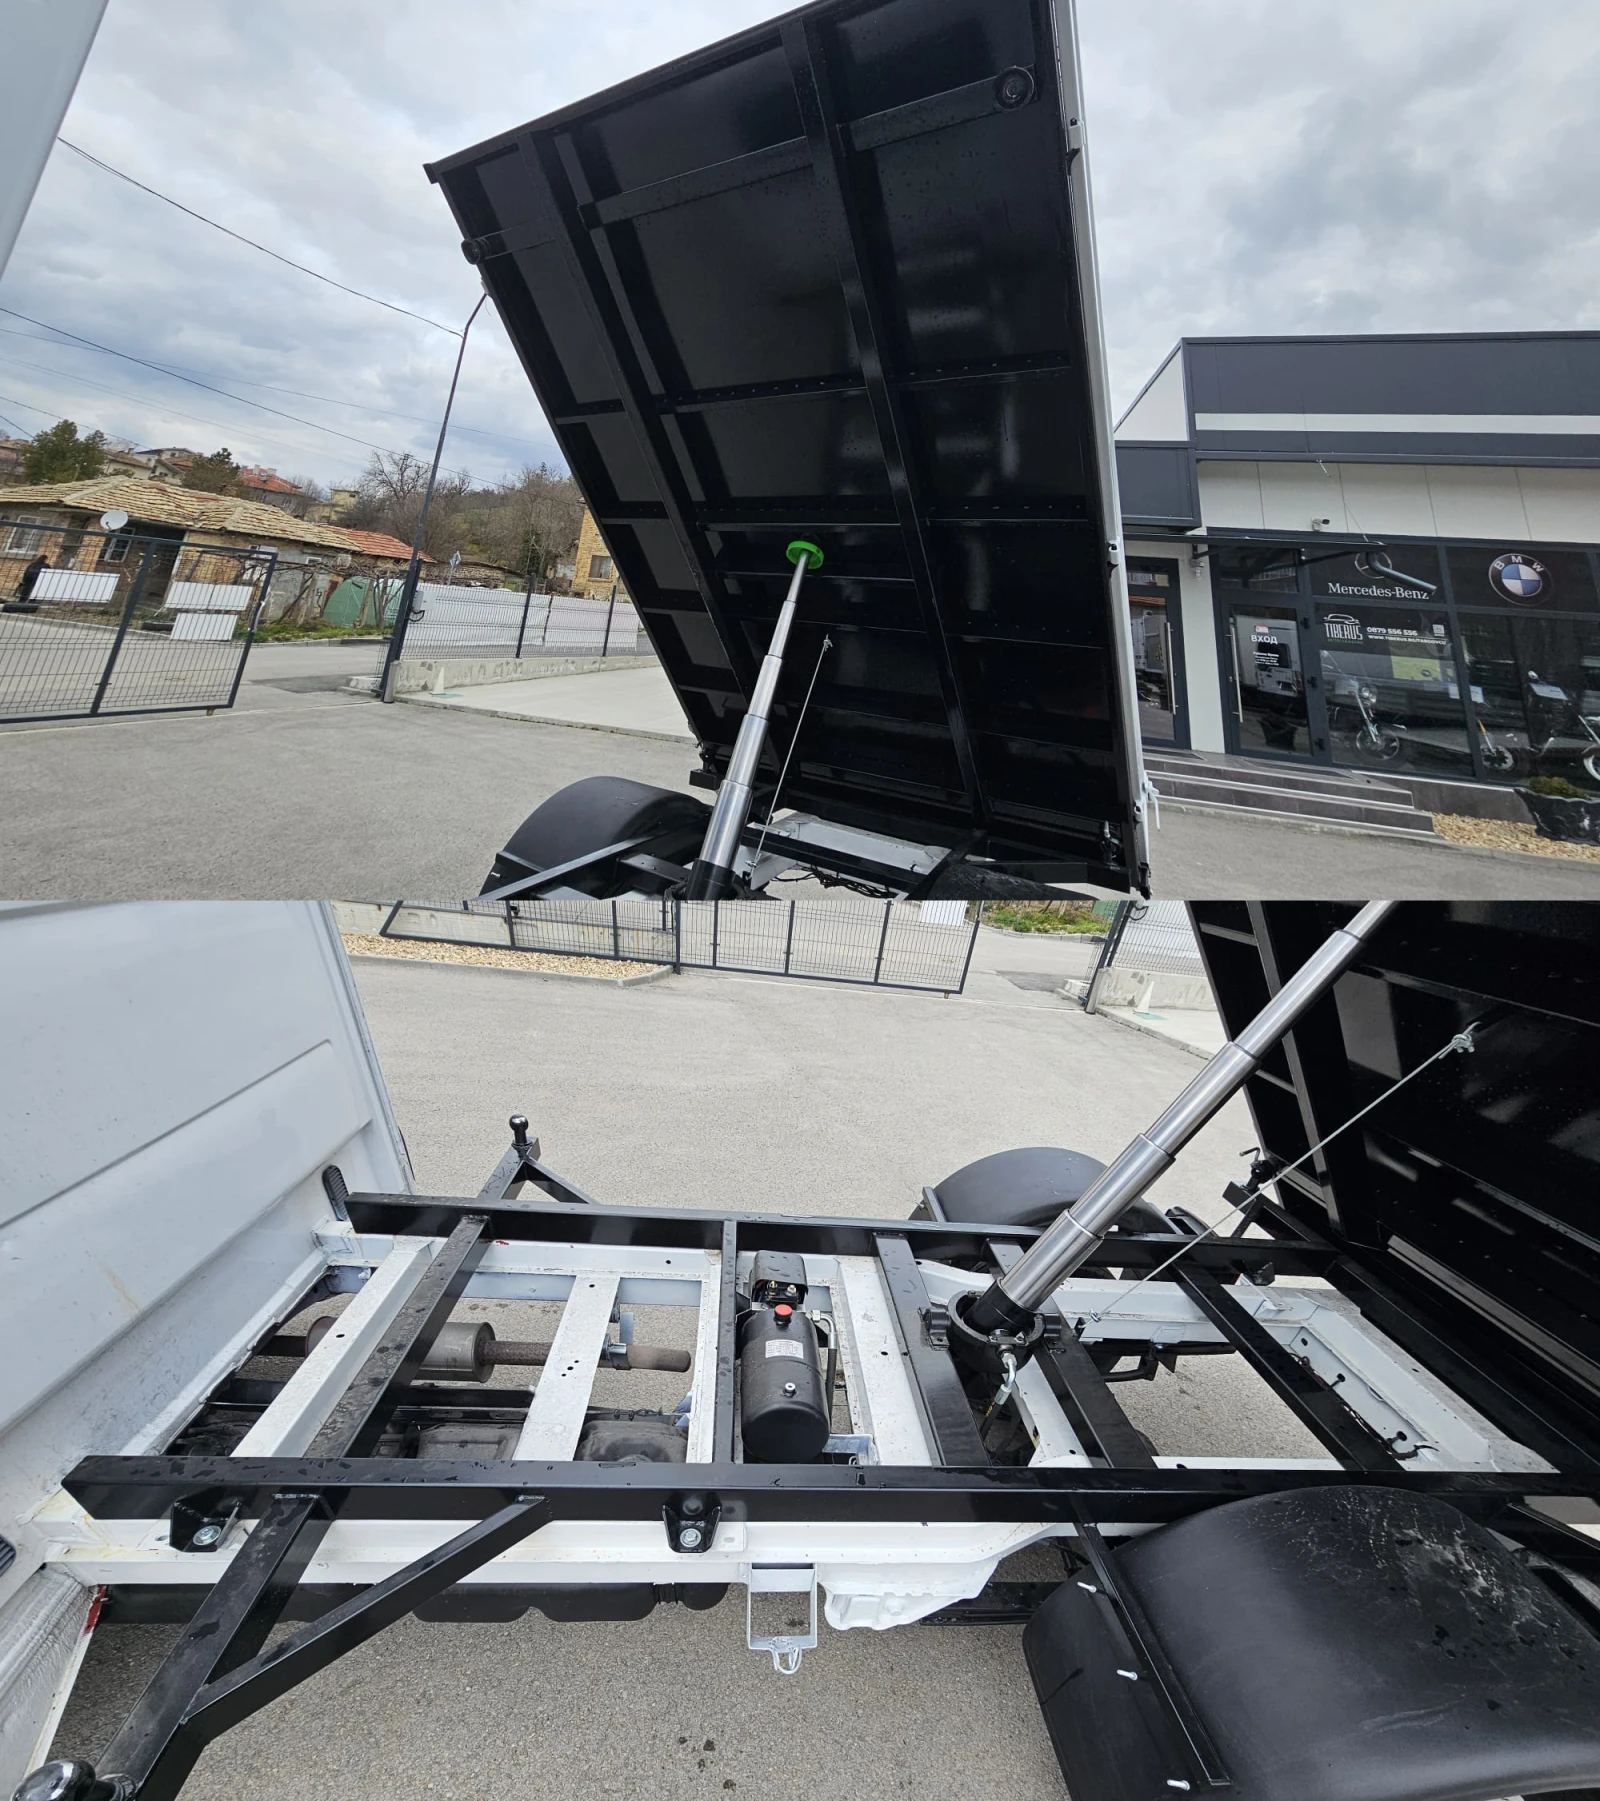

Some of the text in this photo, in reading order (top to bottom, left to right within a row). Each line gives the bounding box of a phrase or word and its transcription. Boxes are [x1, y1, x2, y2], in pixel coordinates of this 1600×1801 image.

[1493, 555, 1545, 572] BMW
[1328, 583, 1429, 600] Mercedes-Benz
[1324, 623, 1363, 640] TIBERUS
[1366, 626, 1387, 634] 0879
[1250, 634, 1278, 645] ВХОД
